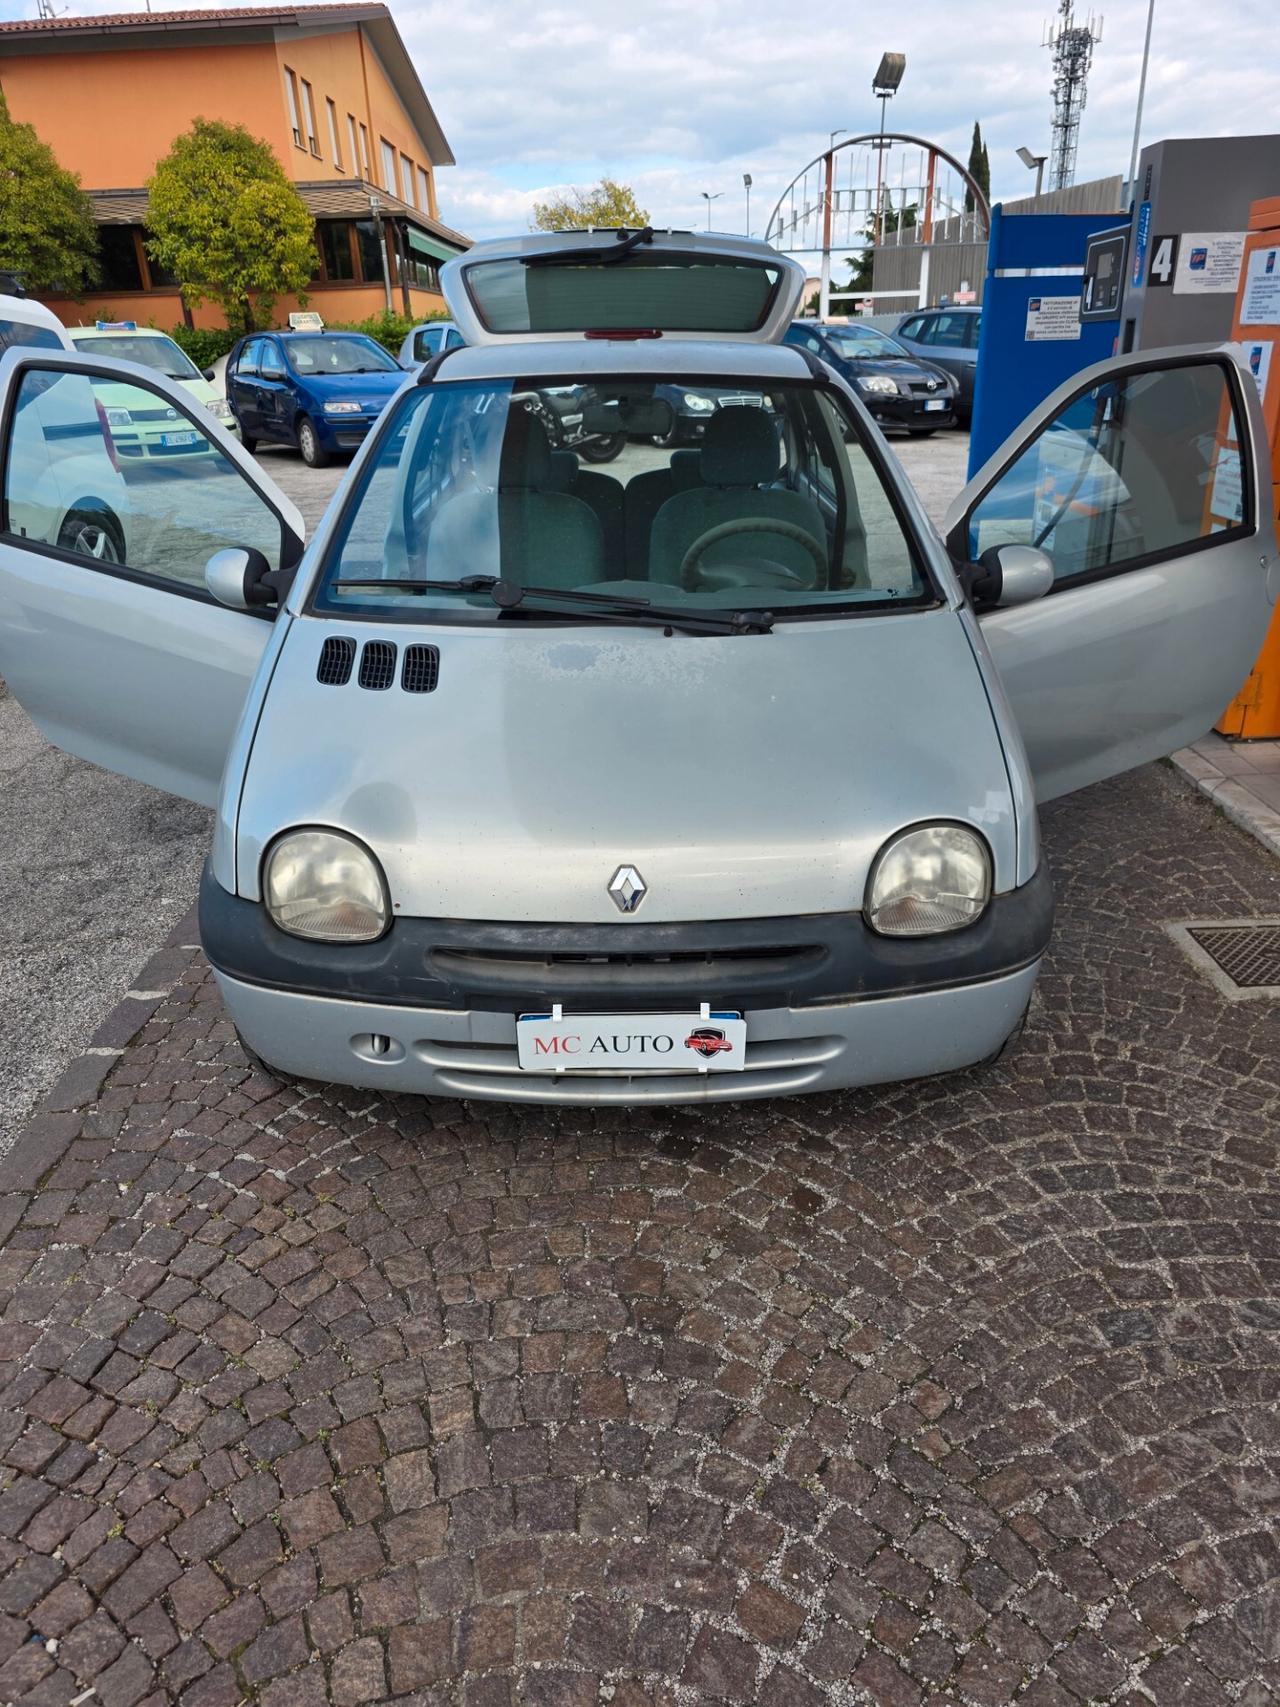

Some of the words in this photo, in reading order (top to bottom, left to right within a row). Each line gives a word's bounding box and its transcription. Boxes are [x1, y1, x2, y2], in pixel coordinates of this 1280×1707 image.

[1152, 238, 1173, 282] 4
[534, 1036, 581, 1054] MC
[589, 1034, 675, 1055] AUTO
